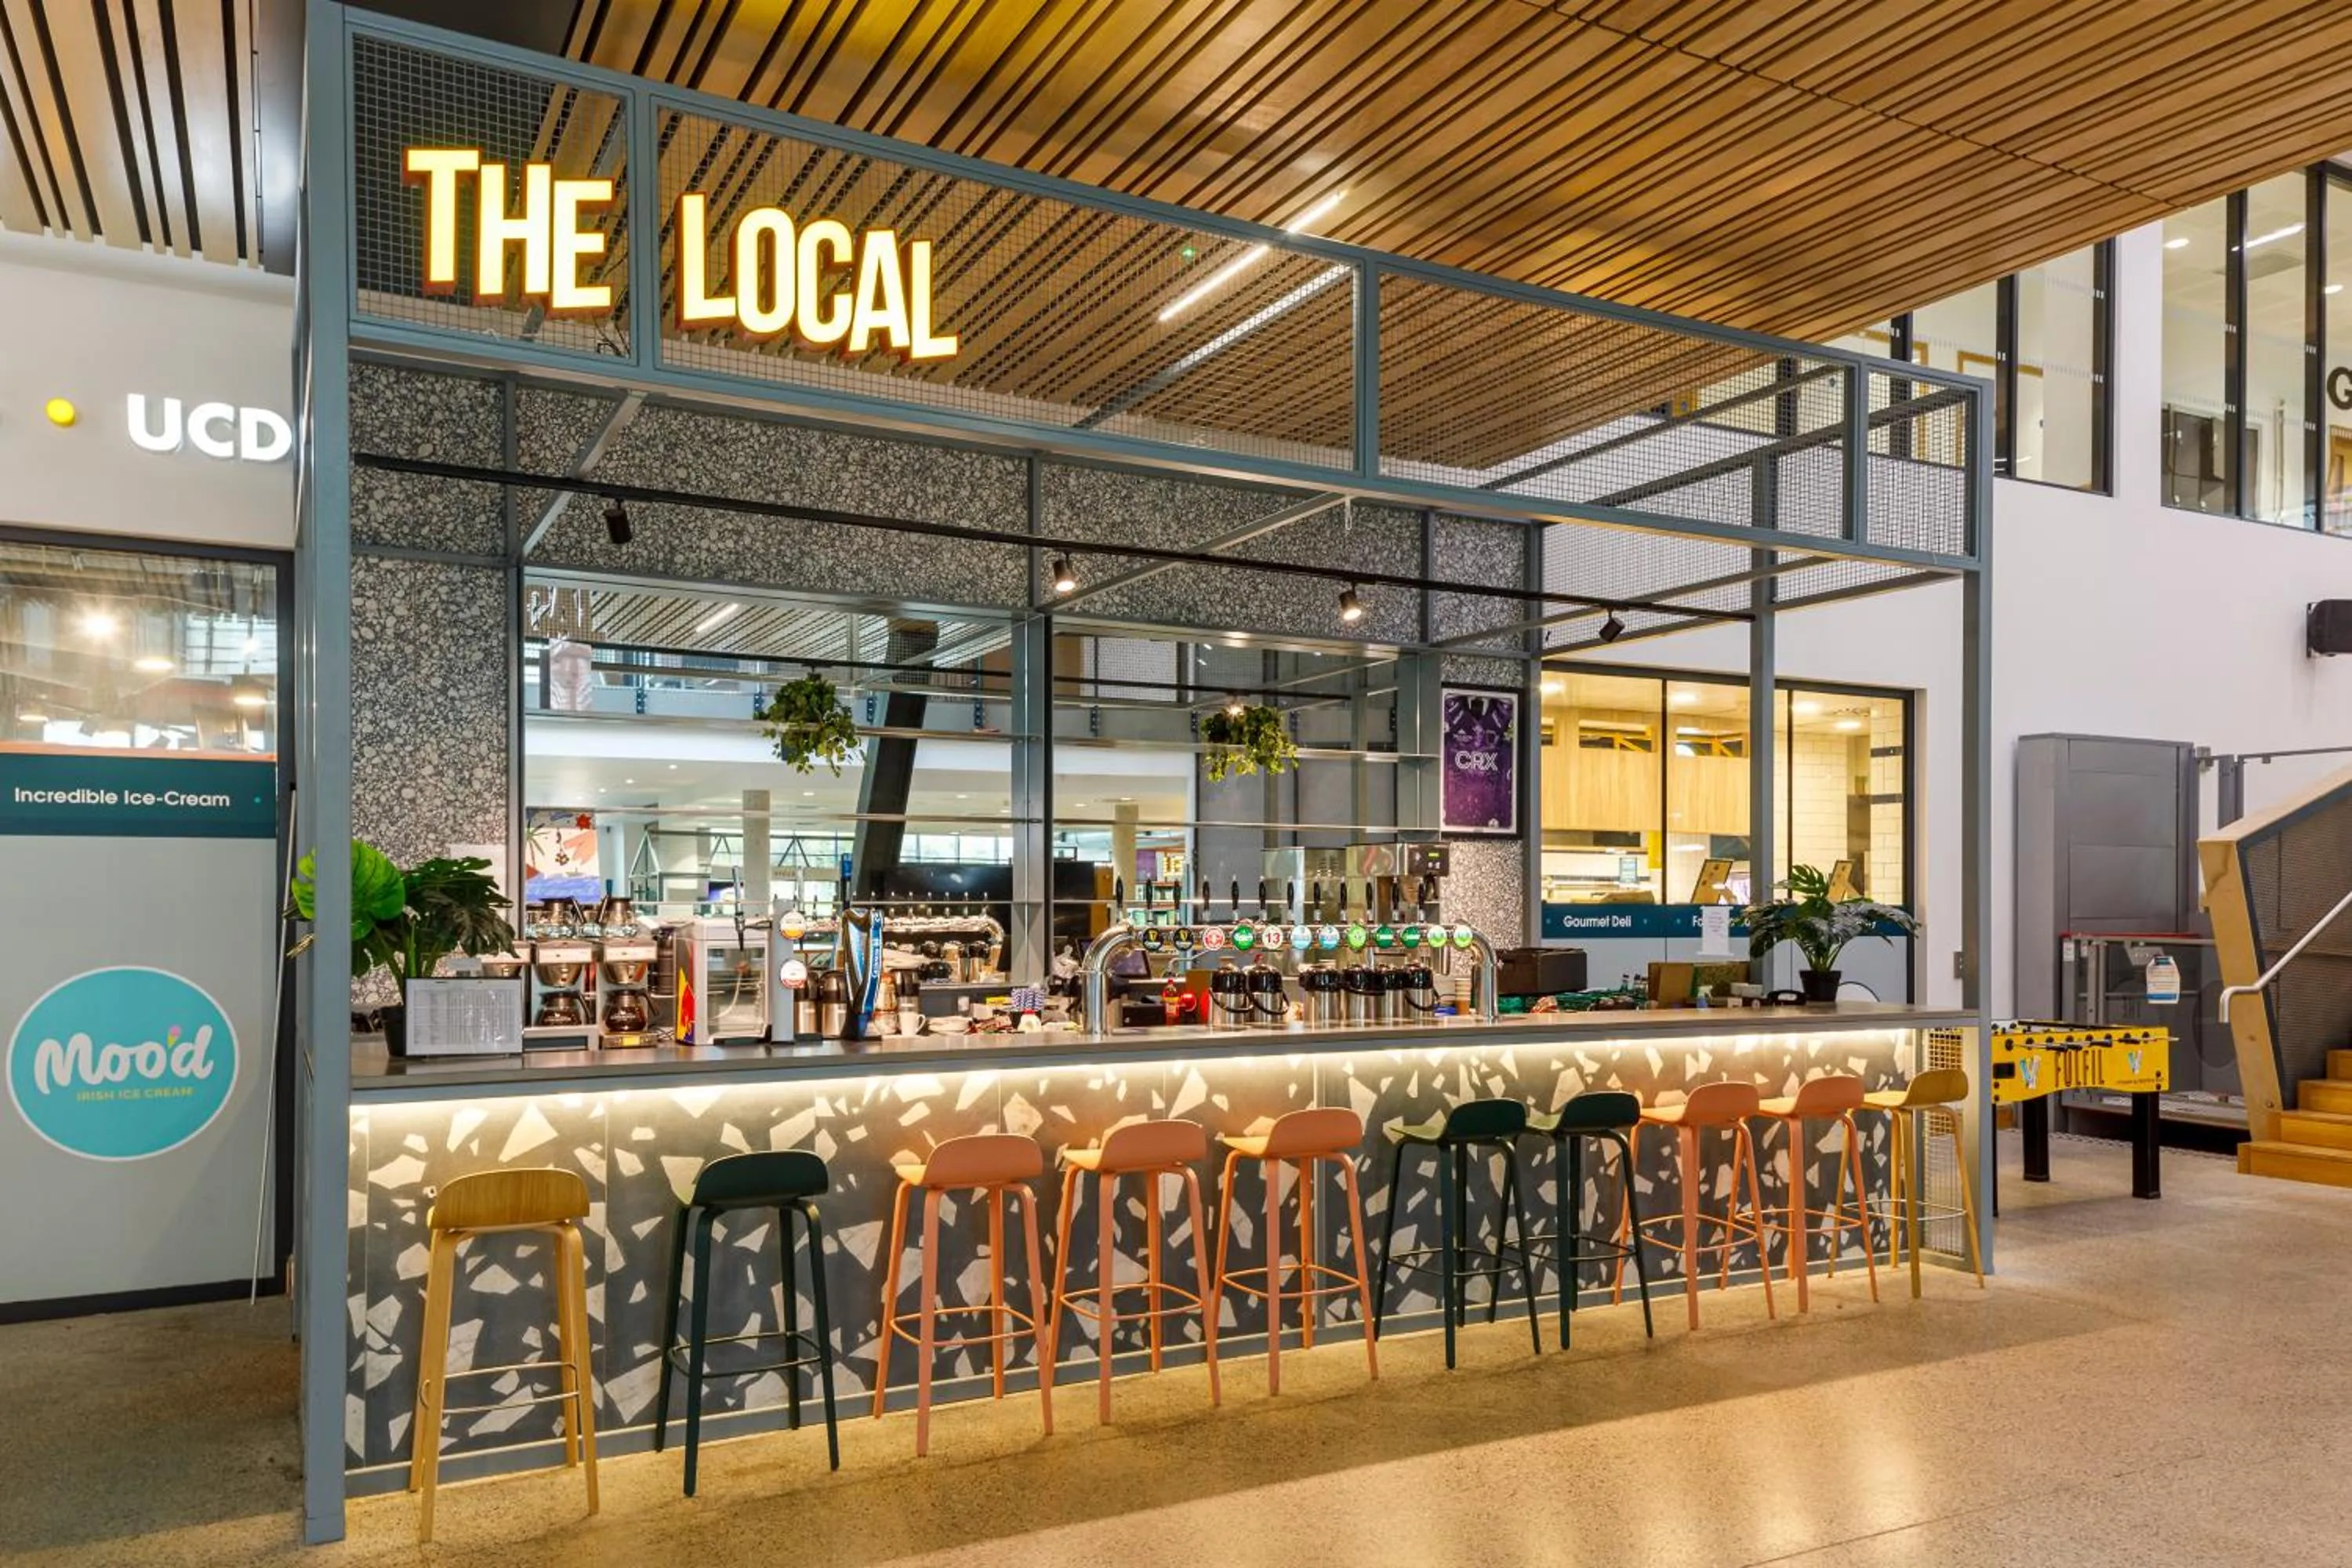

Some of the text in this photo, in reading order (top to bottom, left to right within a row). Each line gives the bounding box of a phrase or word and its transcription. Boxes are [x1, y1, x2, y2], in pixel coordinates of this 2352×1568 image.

[405, 148, 959, 361] THE LOCAL
[126, 393, 292, 462] UCD
[1454, 750, 1498, 771] CRX
[15, 787, 230, 807] Incredible Ice-Cream
[1563, 915, 1632, 928] Gourmet Deli
[1266, 931, 1281, 945] 13
[77, 1086, 194, 1102] IRISH ICE CREAM
